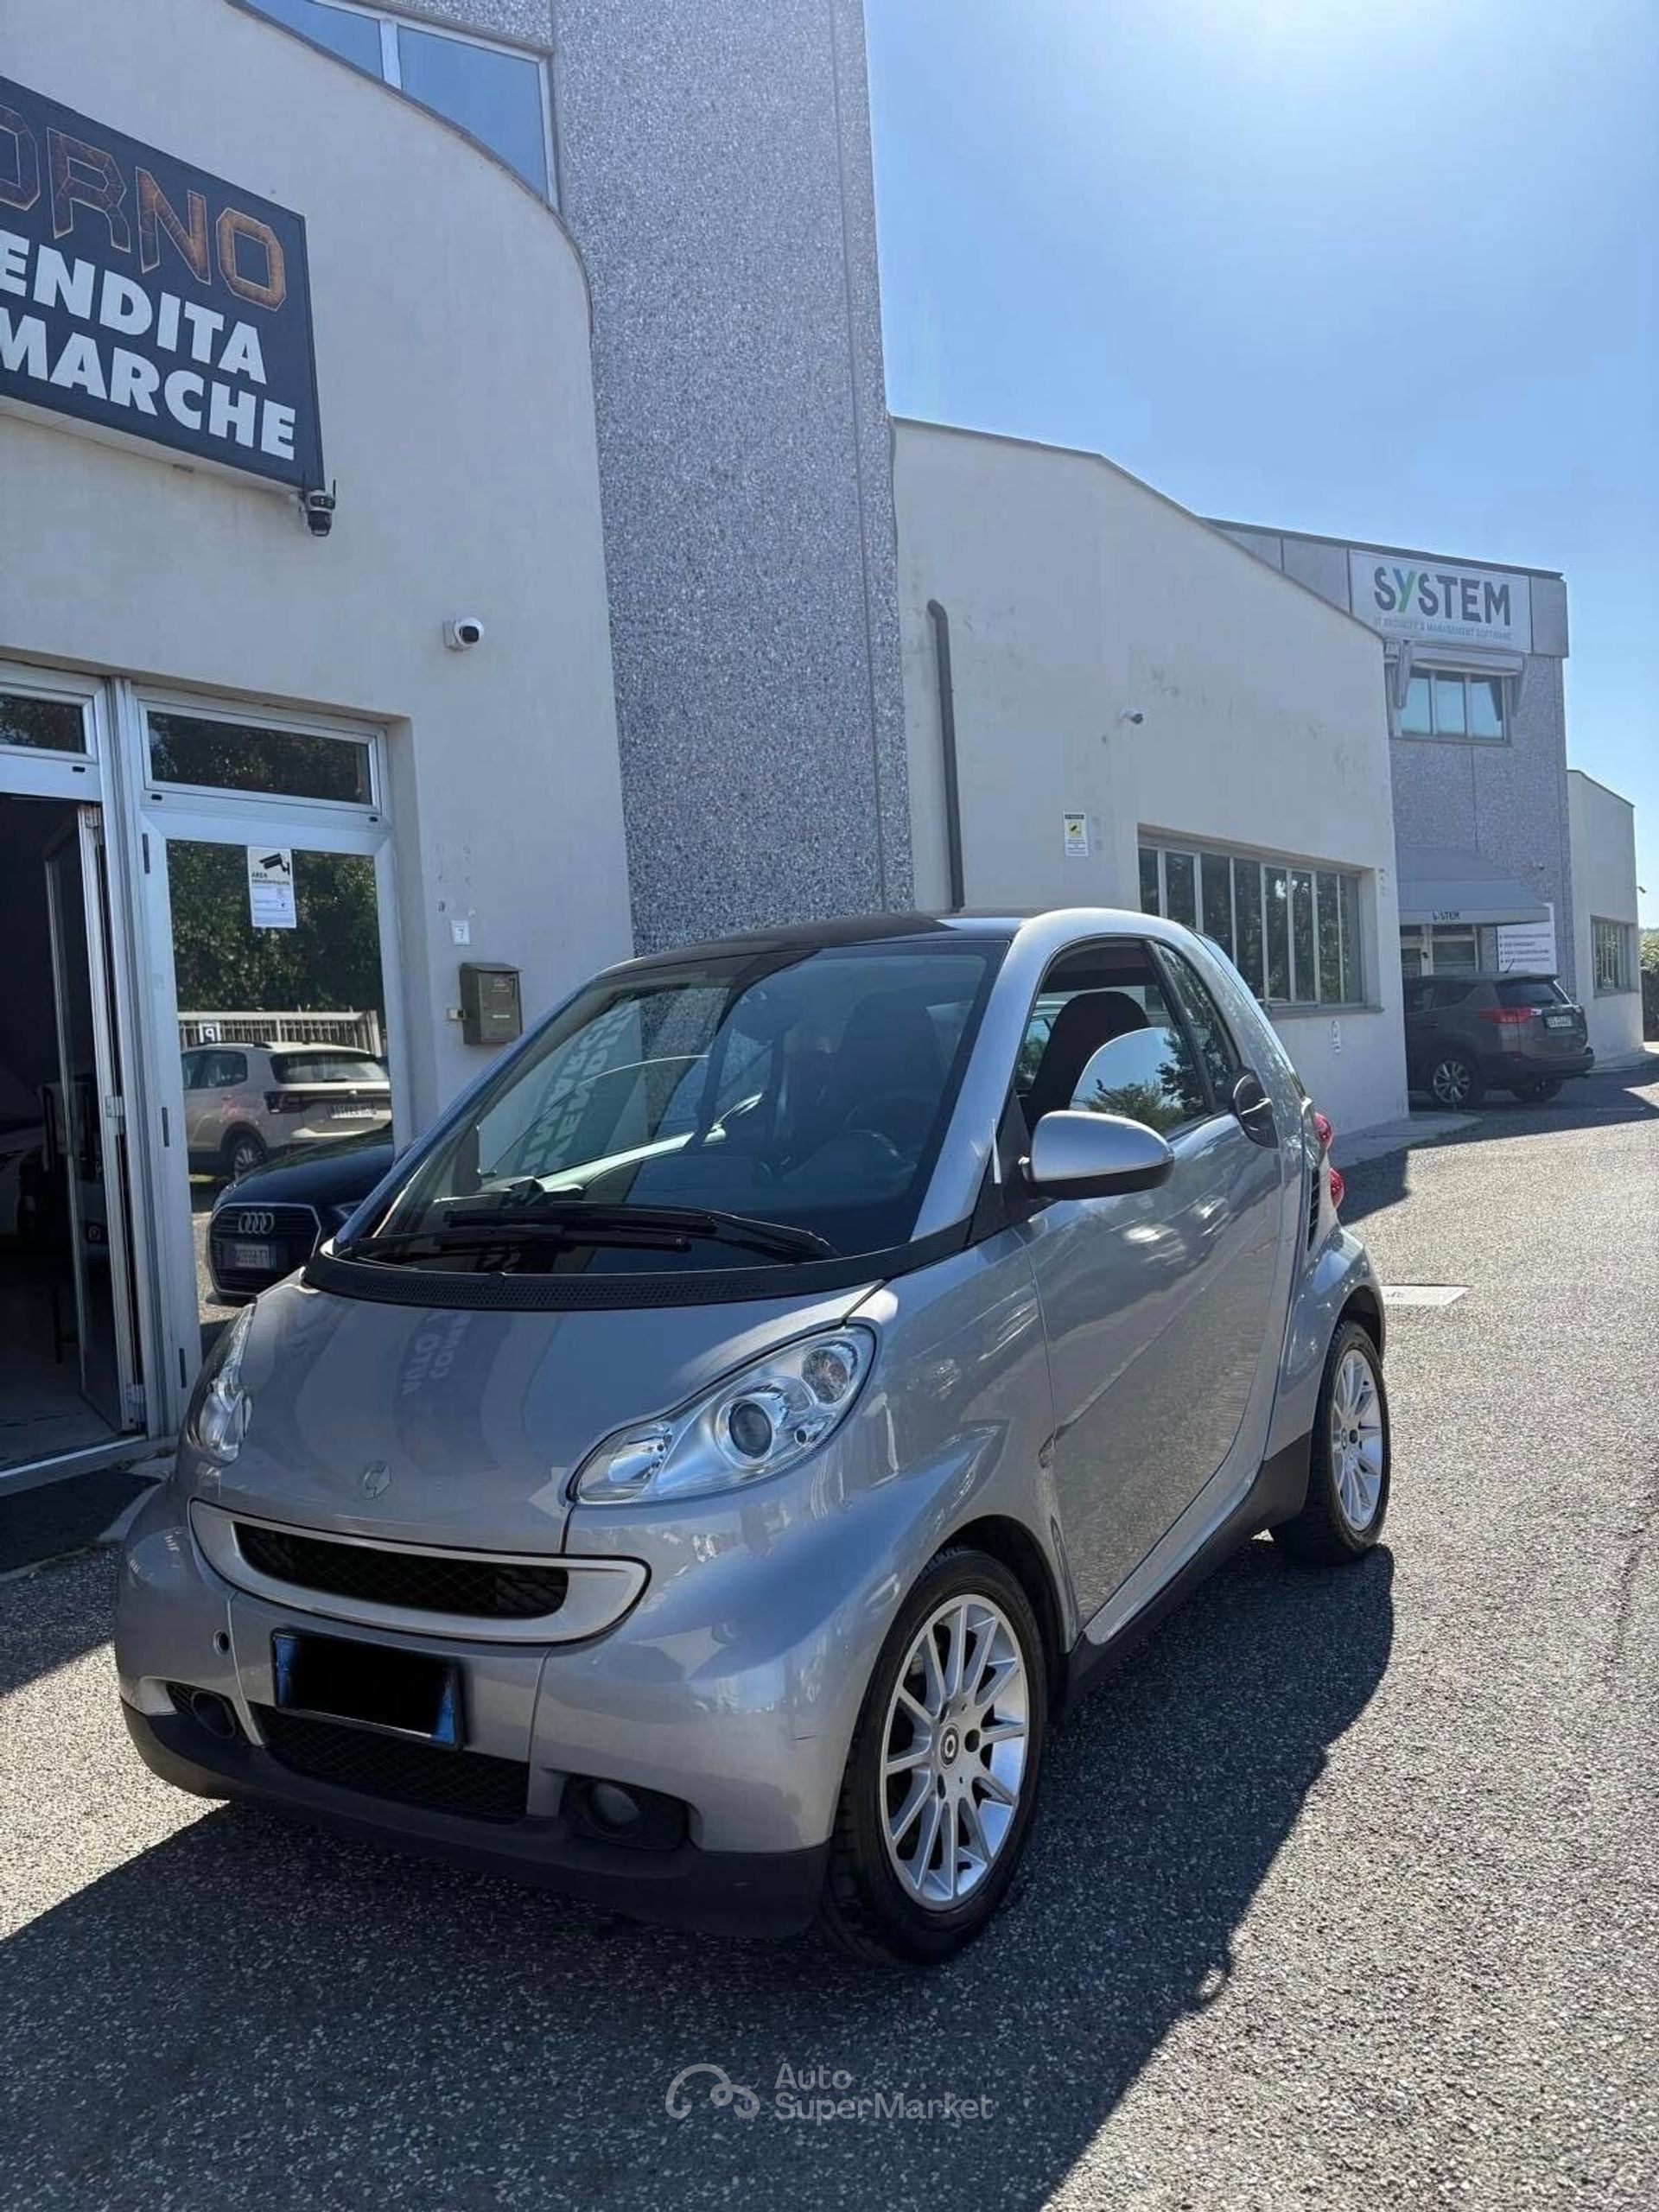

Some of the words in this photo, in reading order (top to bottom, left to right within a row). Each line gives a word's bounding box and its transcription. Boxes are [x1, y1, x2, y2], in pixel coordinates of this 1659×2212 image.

[0, 229, 267, 385] ENDITA
[0, 306, 296, 461] MARCHE
[1374, 566, 1510, 626] SYSTEM
